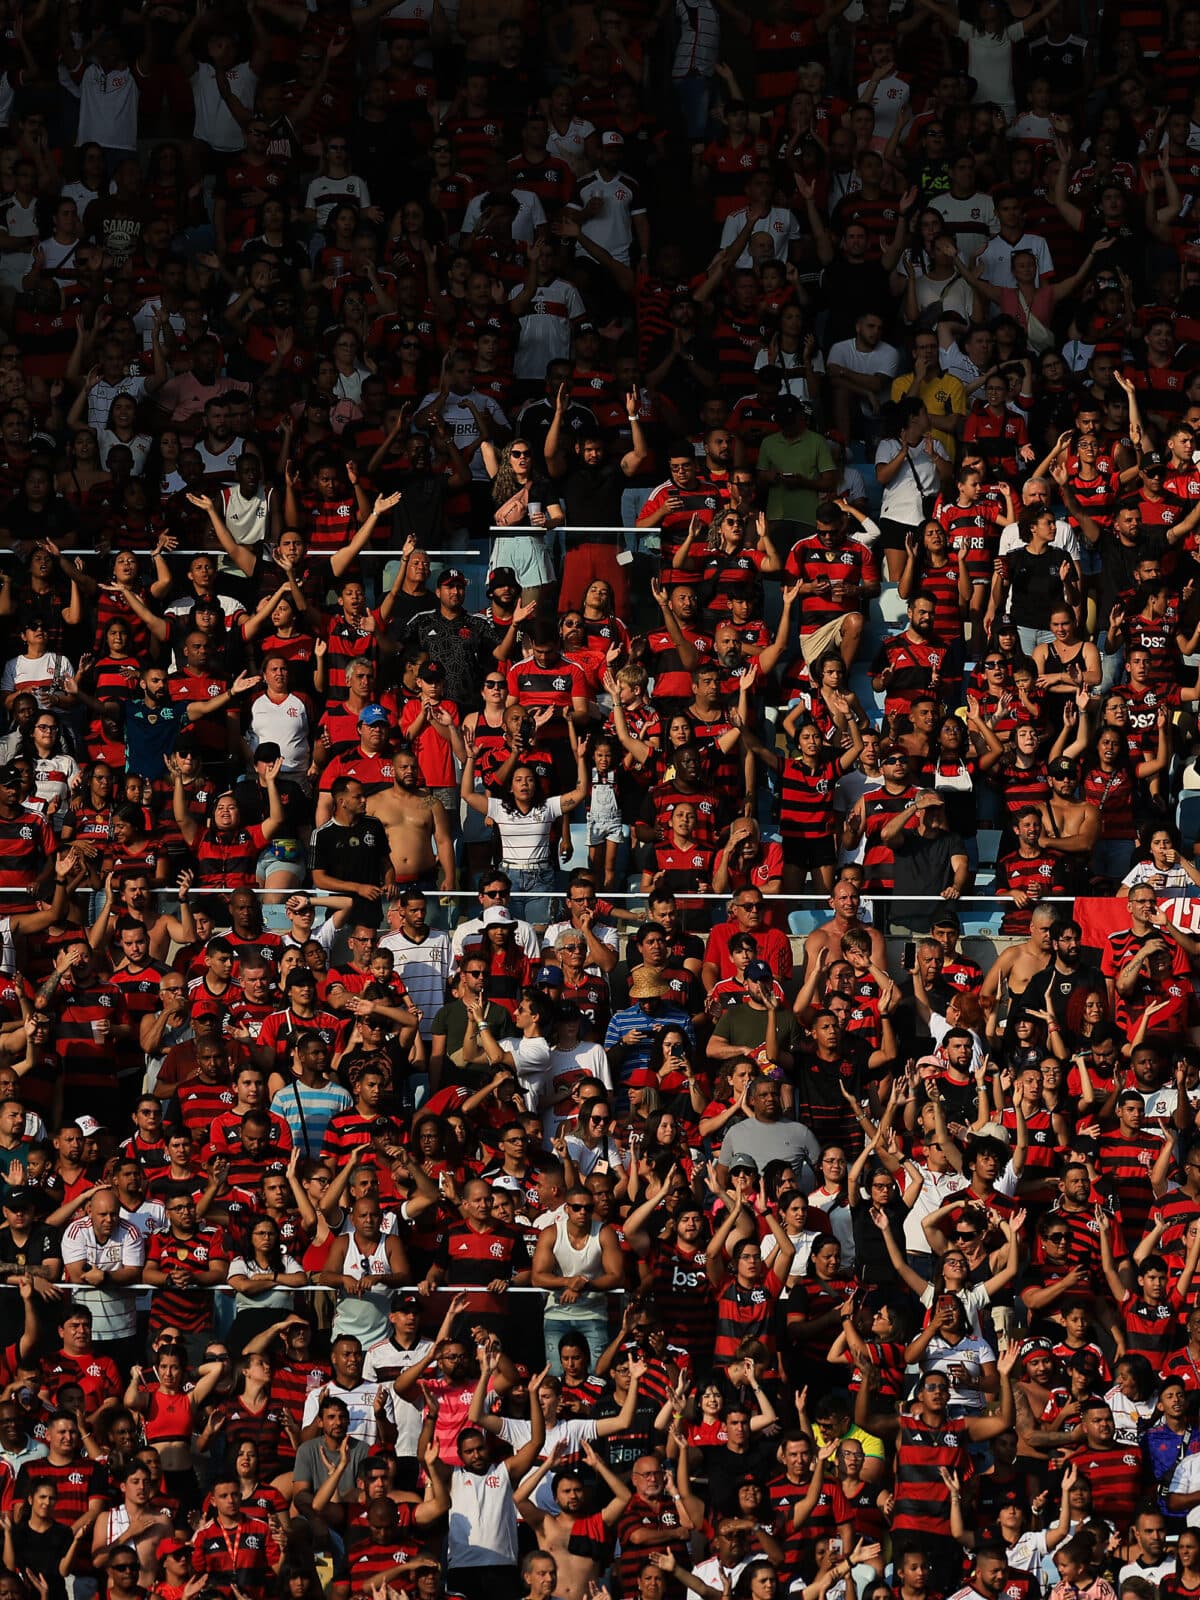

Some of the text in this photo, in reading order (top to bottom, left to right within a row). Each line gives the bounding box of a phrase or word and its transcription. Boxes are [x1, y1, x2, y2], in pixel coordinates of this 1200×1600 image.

[103, 219, 142, 237] SAMBA
[965, 537, 985, 549] RB
[1140, 633, 1167, 649] bs2
[1128, 710, 1156, 729] bs2
[94, 825, 110, 835] BR
